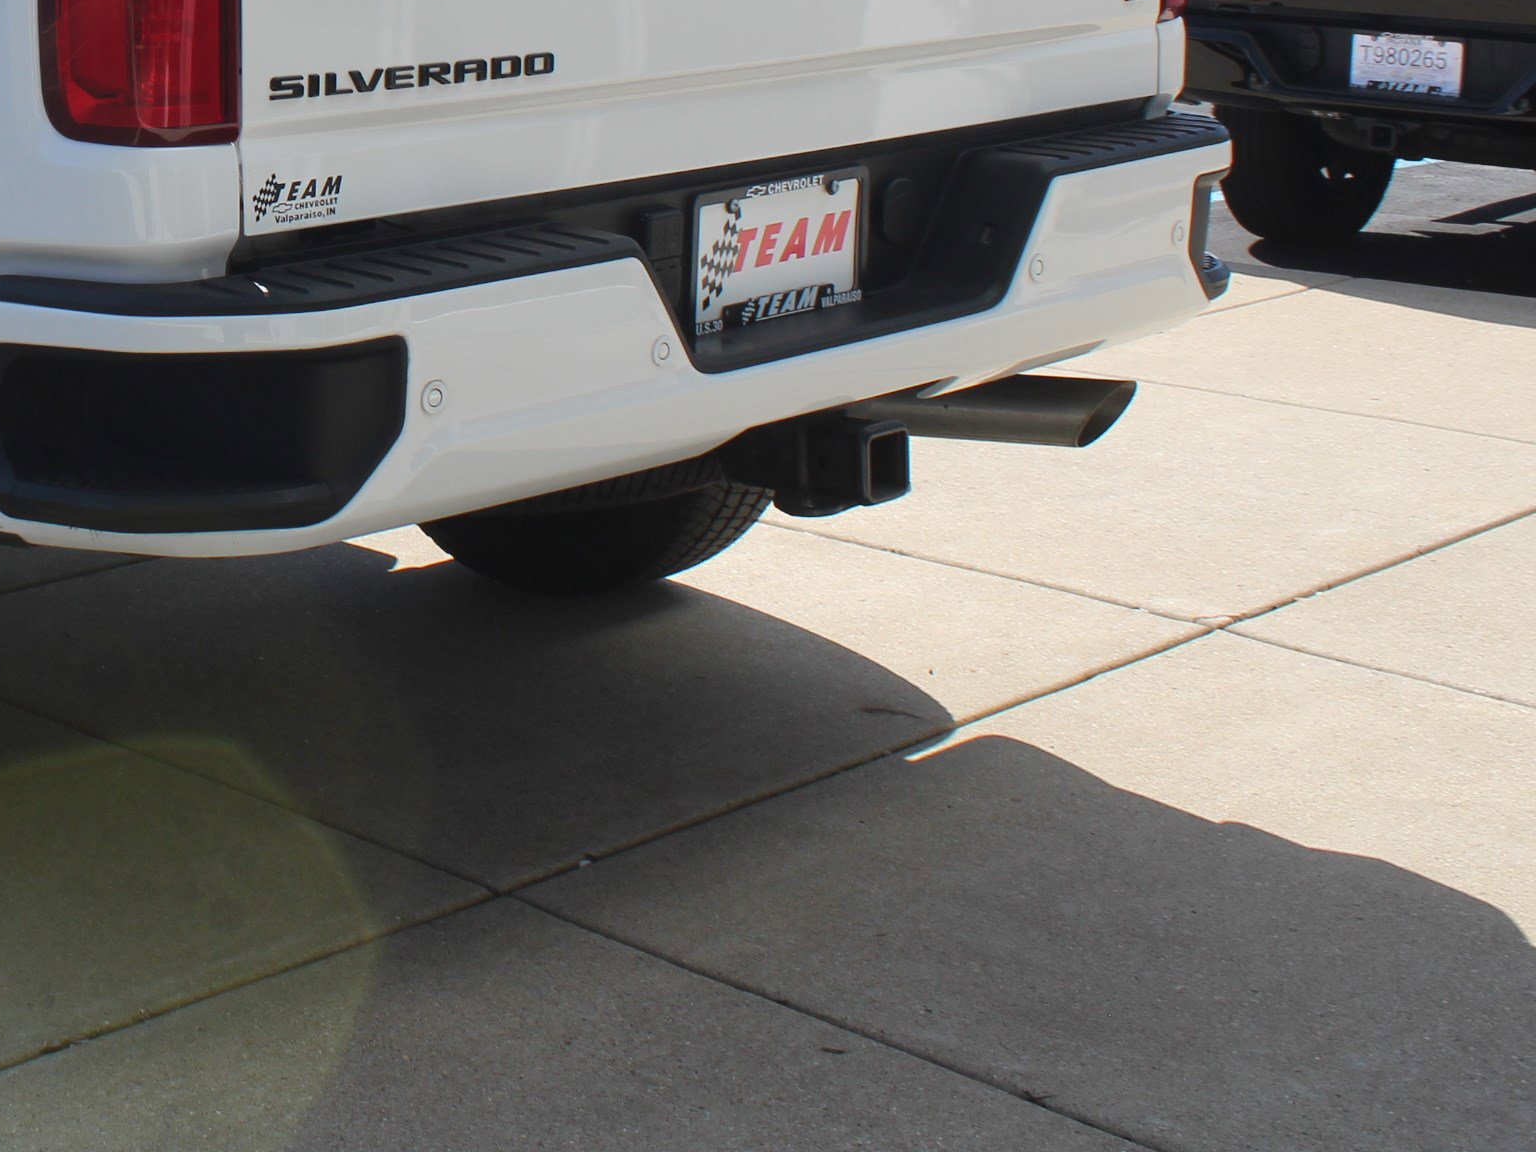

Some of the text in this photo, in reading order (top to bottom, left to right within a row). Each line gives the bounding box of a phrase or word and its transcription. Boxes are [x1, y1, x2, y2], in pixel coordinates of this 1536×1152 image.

[1360, 44, 1447, 69] T980265
[269, 52, 555, 100] SILVERADO
[273, 175, 342, 204] TEAM
[767, 175, 825, 195] CHEVROLET
[275, 207, 336, 223] Valparaiso, IN
[294, 197, 338, 210] CHEVROLET
[733, 210, 852, 273] TEAM
[755, 286, 819, 319] TEAM
